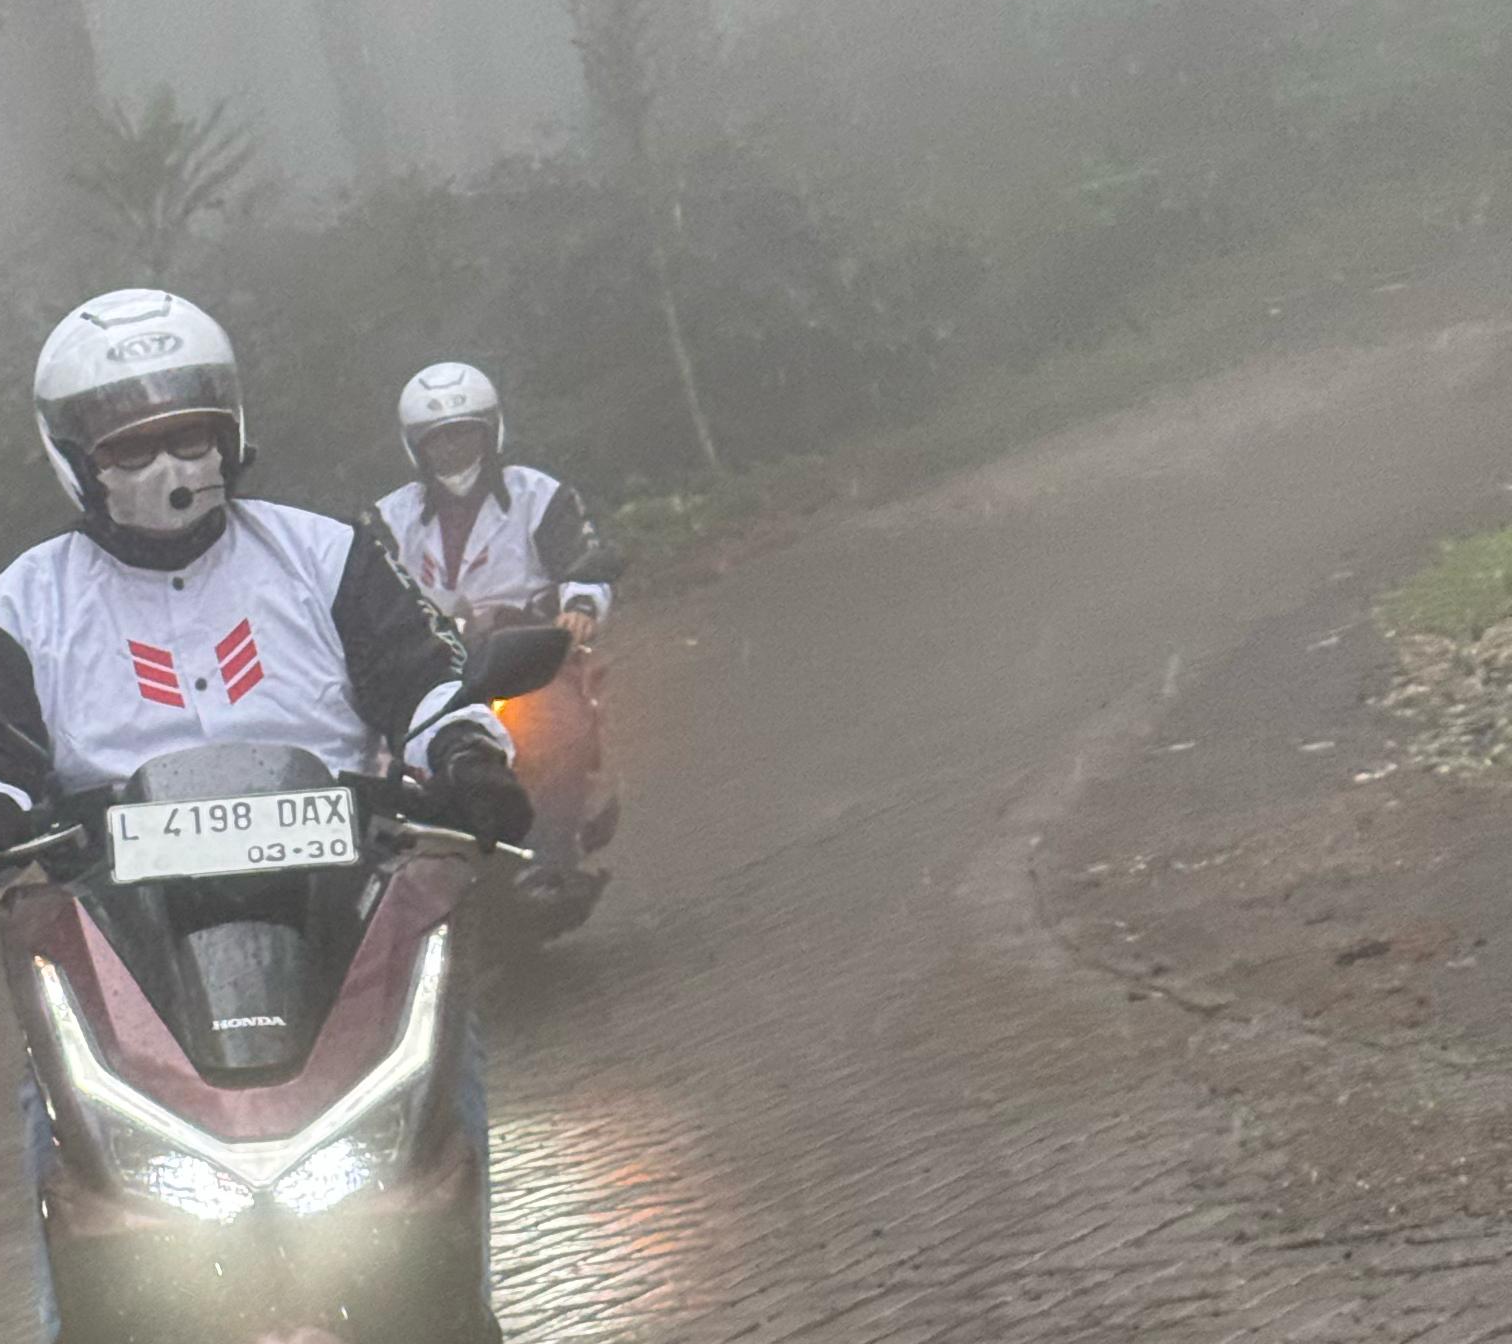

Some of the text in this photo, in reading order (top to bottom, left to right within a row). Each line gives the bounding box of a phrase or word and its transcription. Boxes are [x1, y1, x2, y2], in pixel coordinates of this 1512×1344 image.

[120, 794, 347, 841] L 4198 DAX
[211, 1016, 287, 1031] HONDA
